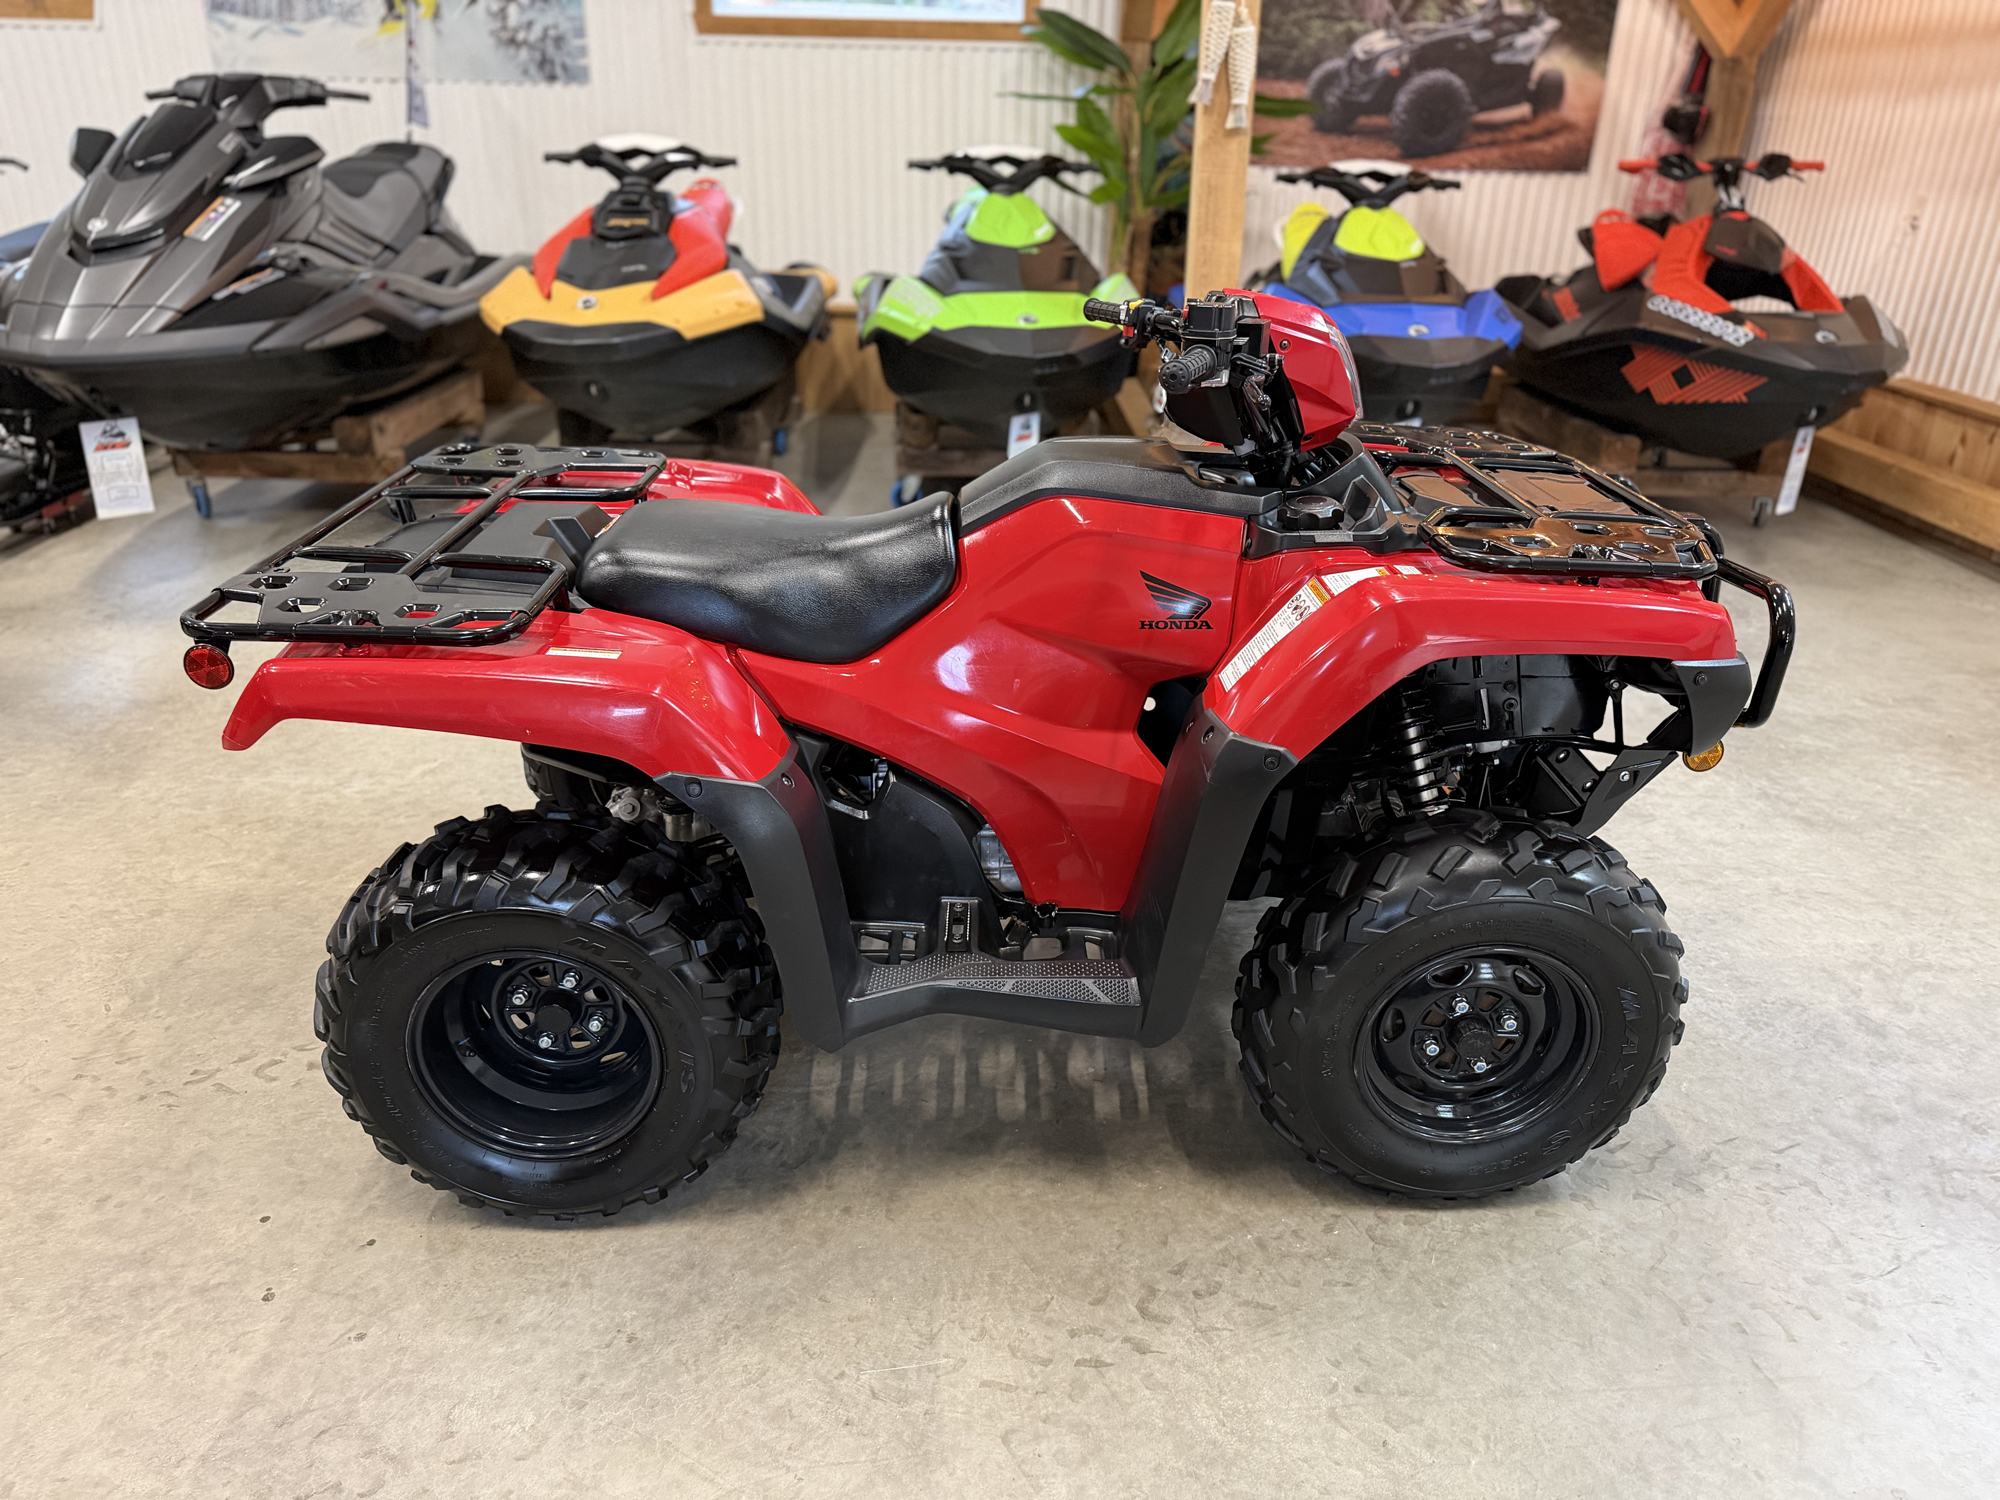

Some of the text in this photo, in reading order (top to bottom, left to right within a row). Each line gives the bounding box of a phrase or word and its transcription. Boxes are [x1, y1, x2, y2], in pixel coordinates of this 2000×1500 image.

[1139, 620, 1213, 630] HONDA
[559, 936, 696, 1093] MAXIS
[1540, 986, 1643, 1155] MAXXIS
